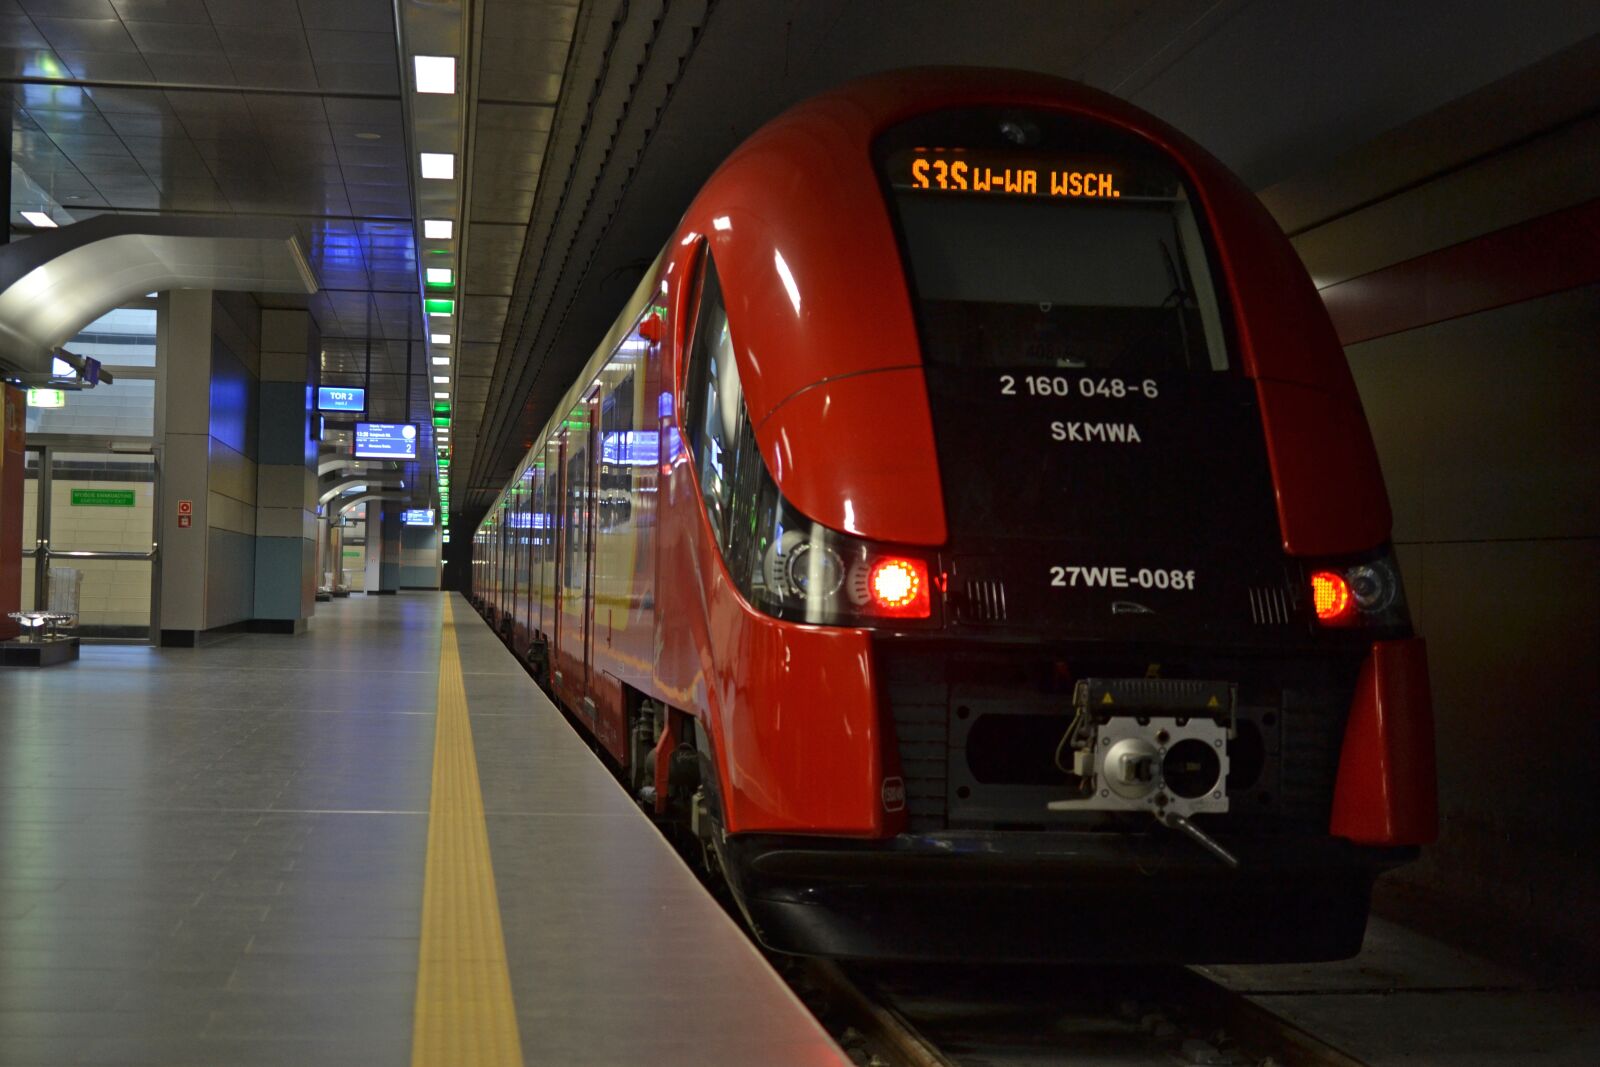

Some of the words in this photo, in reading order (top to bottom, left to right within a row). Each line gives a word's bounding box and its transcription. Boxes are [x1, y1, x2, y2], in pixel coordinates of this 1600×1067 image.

[973, 167, 1037, 195] W-WA
[1050, 171, 1120, 197] WSCH.
[329, 391, 347, 401] TOR
[348, 392, 353, 401] 2
[999, 375, 1016, 395] 2
[1025, 375, 1068, 396] 160
[1079, 377, 1159, 399] 048-6
[1050, 421, 1142, 443] SKMWA
[405, 443, 412, 453] 2
[1049, 566, 1196, 590] 27WE-008f
